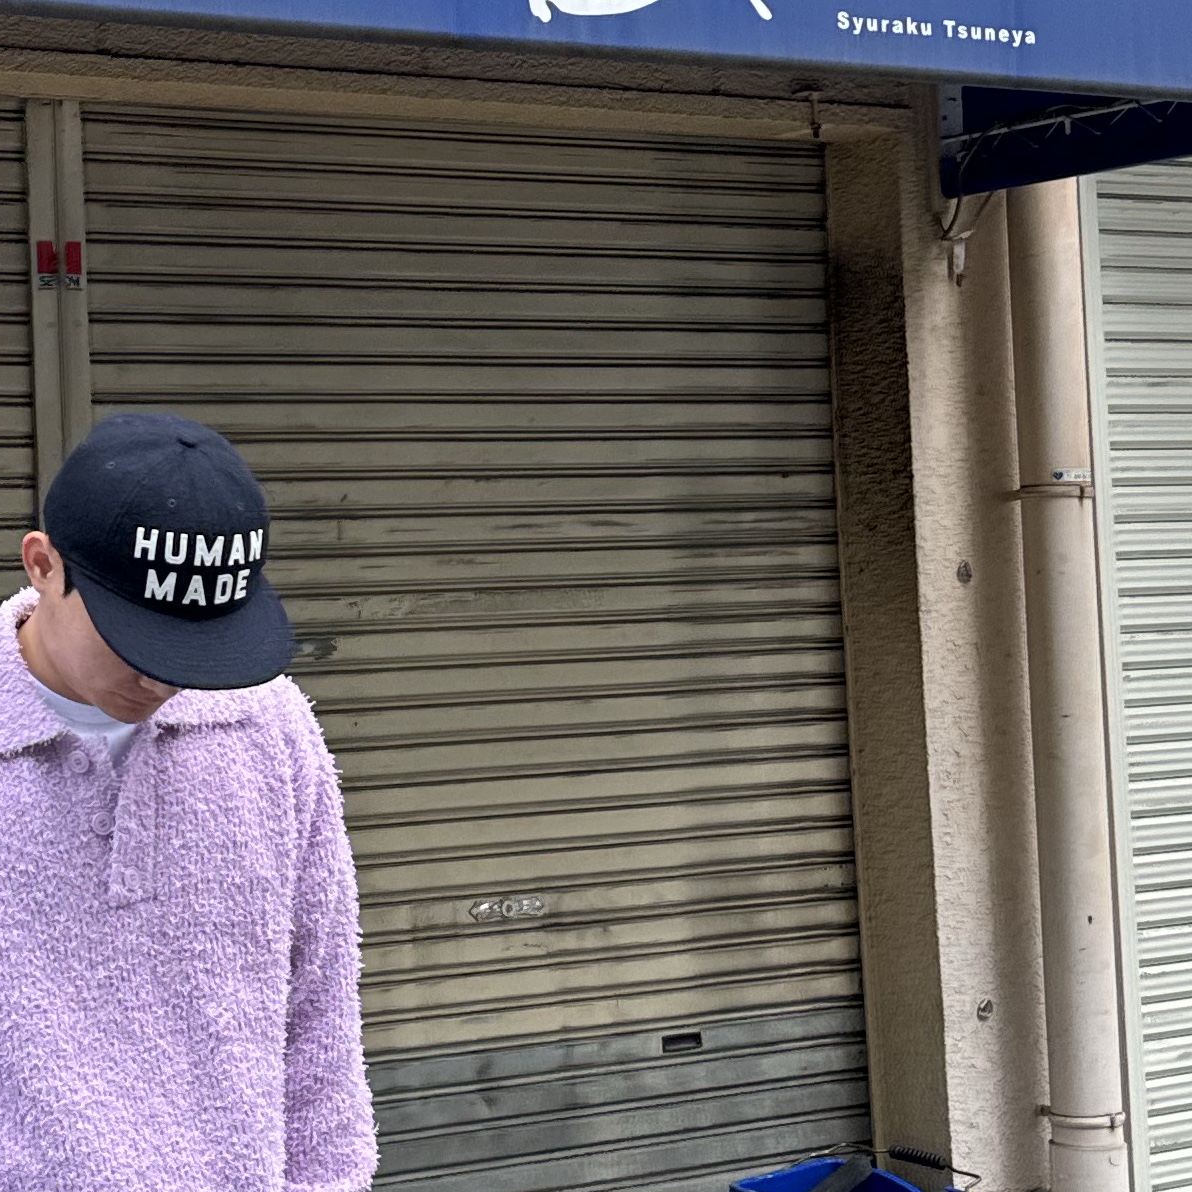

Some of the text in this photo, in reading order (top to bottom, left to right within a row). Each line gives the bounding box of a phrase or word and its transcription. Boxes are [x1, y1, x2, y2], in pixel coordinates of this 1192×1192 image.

[837, 11, 1036, 48] Syuraku Tsuneya
[133, 526, 264, 567] HUMAN
[144, 568, 251, 606] MADE
